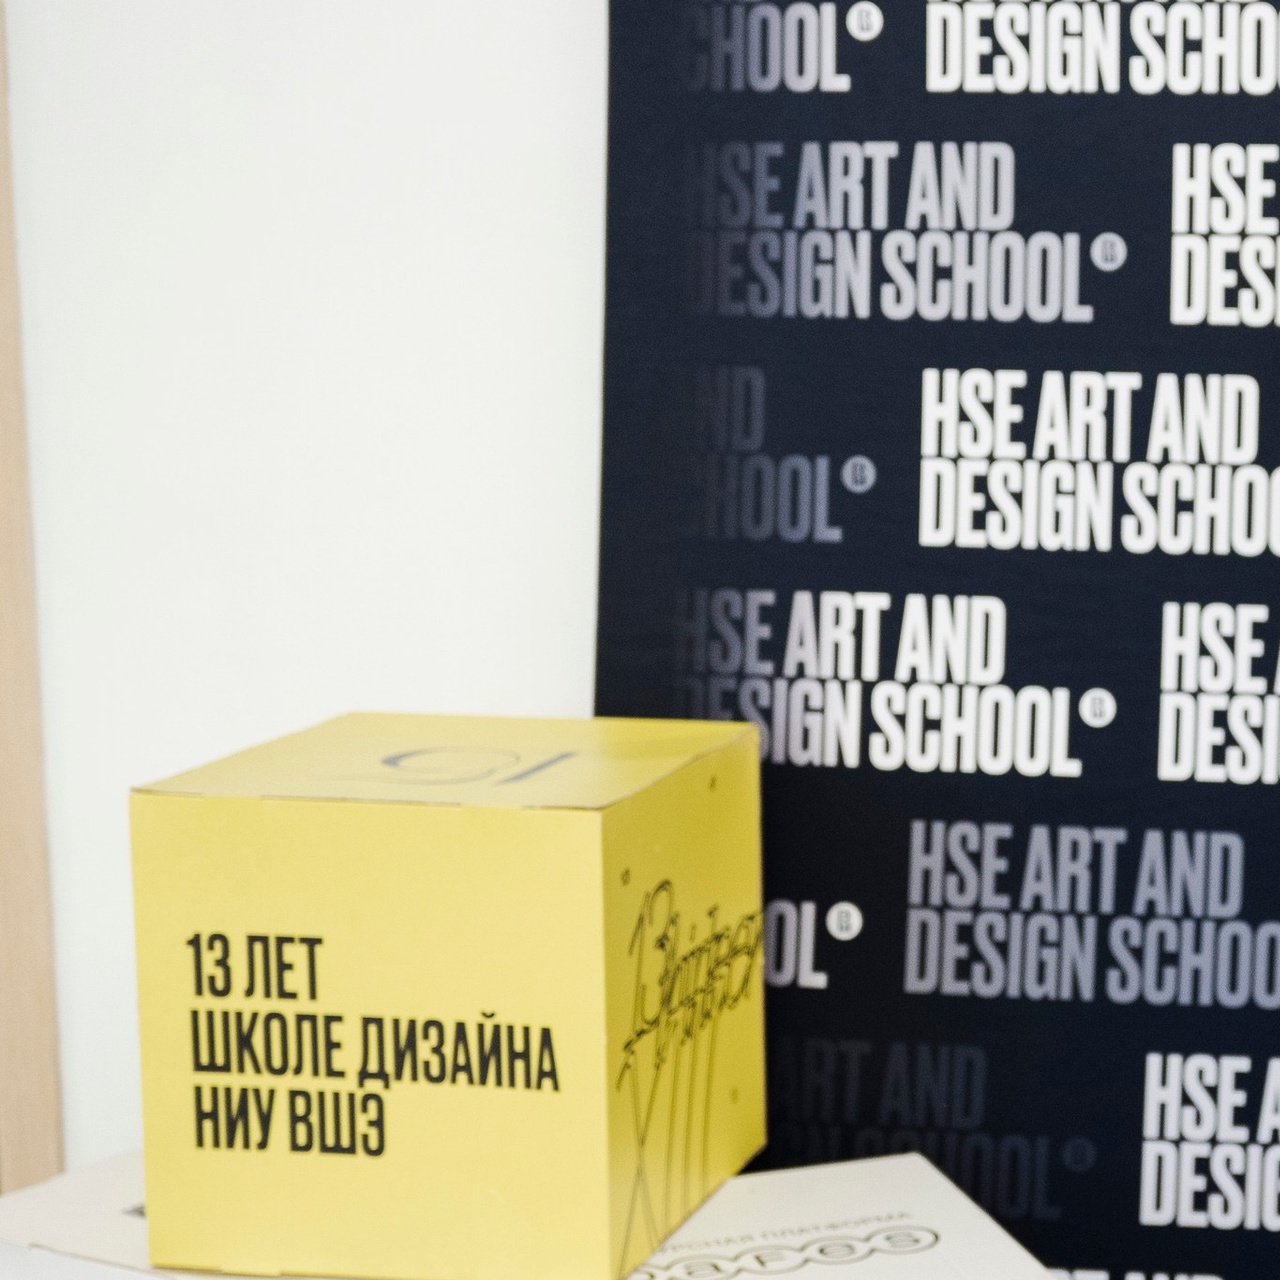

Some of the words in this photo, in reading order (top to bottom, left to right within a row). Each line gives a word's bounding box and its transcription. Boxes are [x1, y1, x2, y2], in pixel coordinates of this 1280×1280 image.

[707, 1, 852, 95] HOOL
[924, 2, 1121, 96] DESIGN
[794, 141, 899, 231] ART
[905, 140, 1016, 231] AND
[1172, 143, 1280, 236] HSE
[879, 230, 1095, 324] SCHOOL
[921, 367, 1027, 461] HSE
[1032, 370, 1144, 464] ART
[1147, 372, 1261, 466] AND
[919, 457, 1112, 553] DESIGN
[783, 589, 892, 682] ART
[895, 592, 1008, 688] AND
[1161, 601, 1269, 694] HSE
[684, 676, 861, 769] SIGN
[869, 681, 1084, 778] SCHOOL
[907, 820, 1012, 909] HSE
[1020, 824, 1128, 916] ART
[1134, 828, 1246, 919] AND
[186, 932, 232, 998] 13
[243, 934, 324, 1001] ЛЕТ
[904, 907, 1098, 1004] DESIGN
[190, 1010, 345, 1081] ШКОЛЕ
[357, 1012, 561, 1093] ДИЗАЙНА
[1143, 1051, 1252, 1145] HSE
[192, 1085, 276, 1152] НИУ
[288, 1090, 387, 1157] ВШЭ
